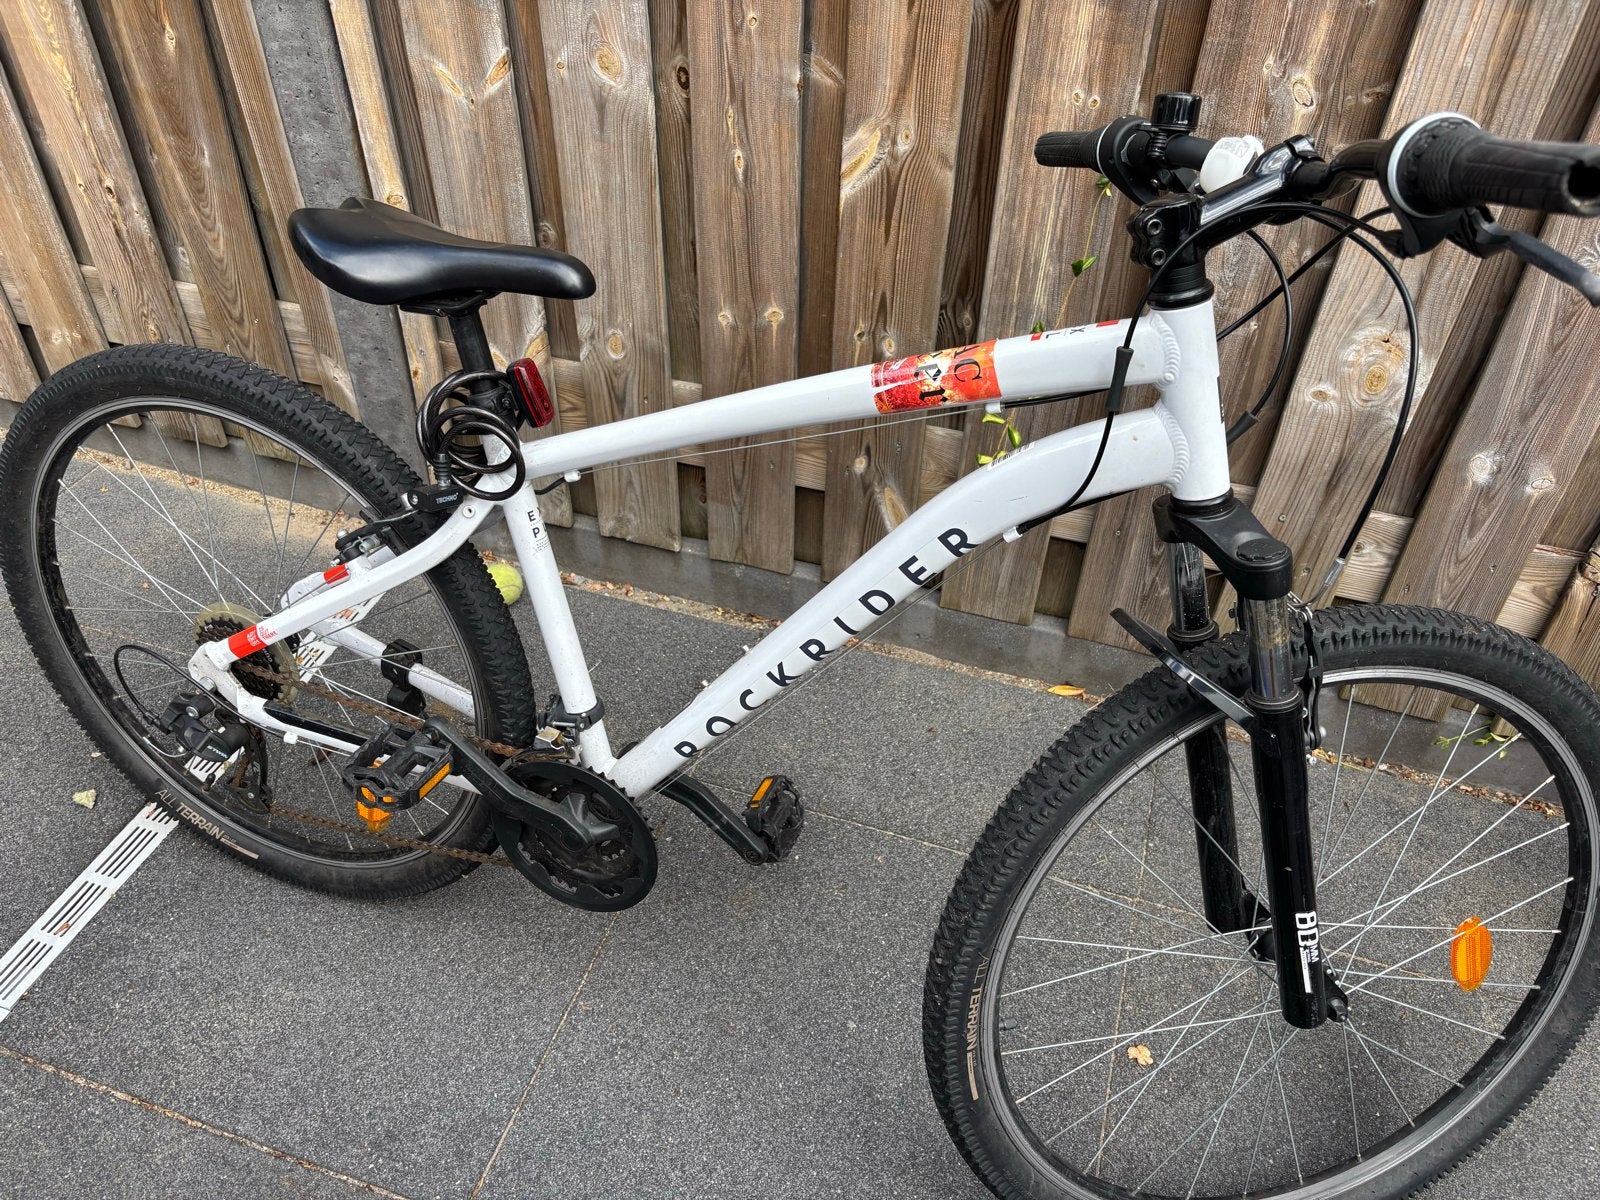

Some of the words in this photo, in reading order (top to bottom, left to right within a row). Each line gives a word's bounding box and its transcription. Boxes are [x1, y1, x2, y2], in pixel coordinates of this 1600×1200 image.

[673, 527, 978, 758] ROCKRIDER
[154, 789, 176, 809] ALL
[176, 802, 225, 840] TERRAIN
[974, 951, 990, 984] ALL
[967, 986, 982, 1050] TERRAIN
